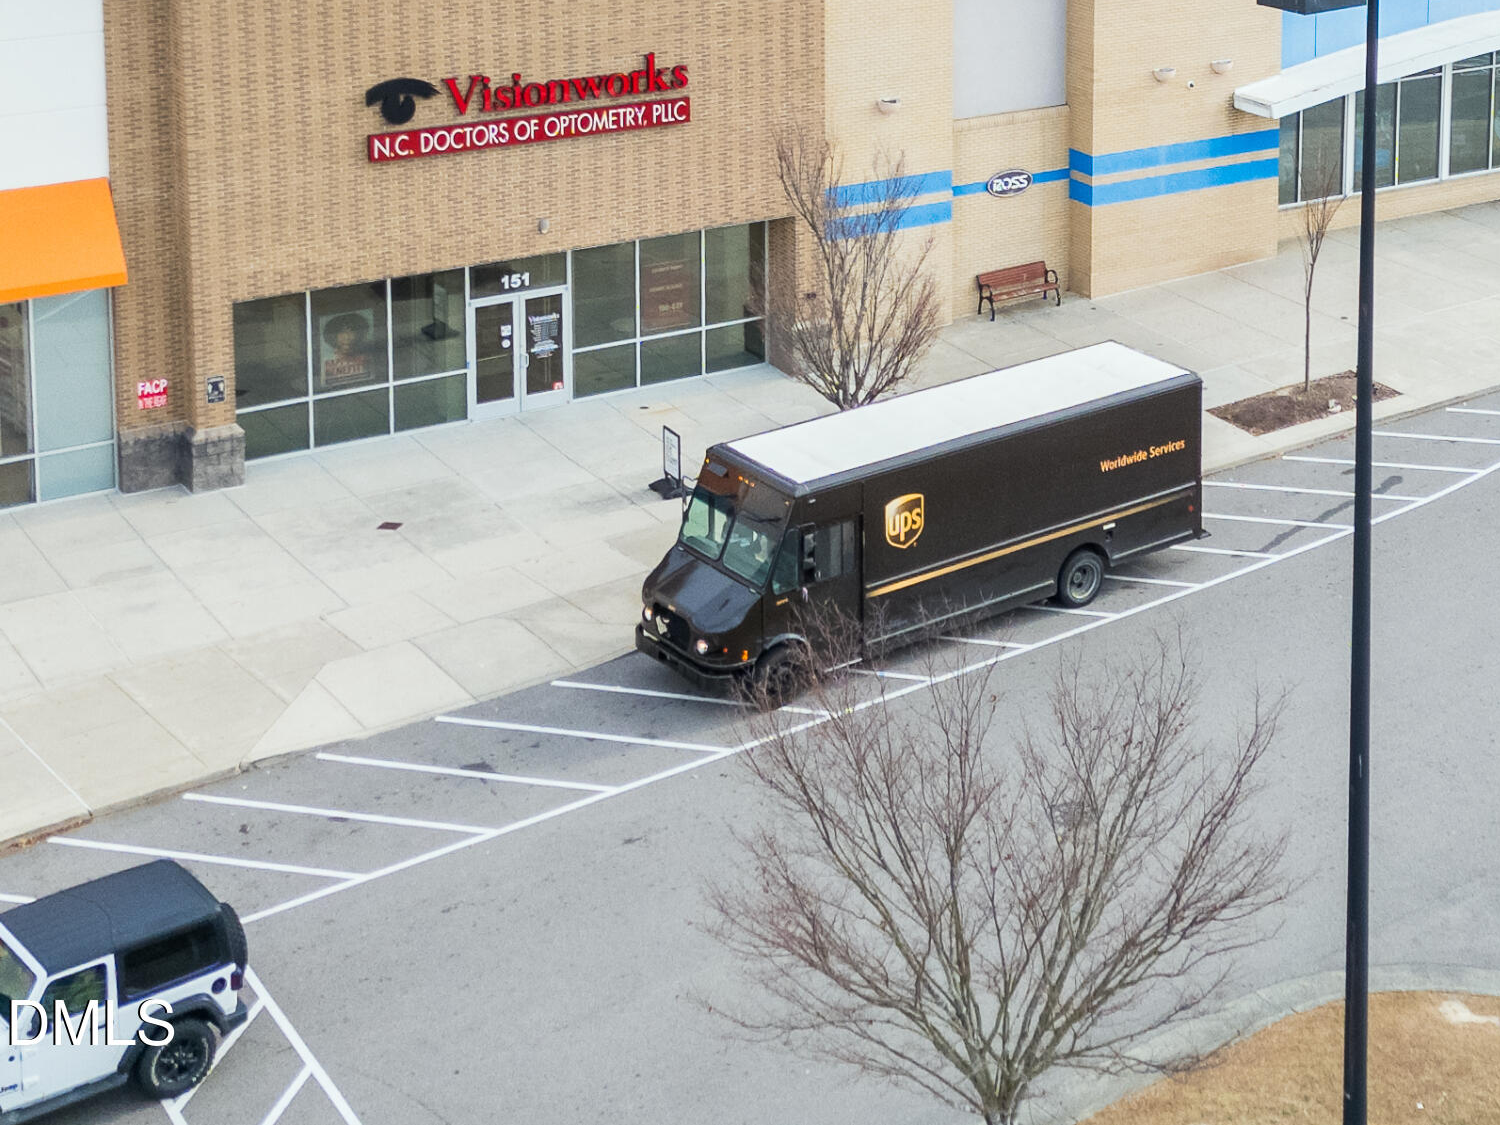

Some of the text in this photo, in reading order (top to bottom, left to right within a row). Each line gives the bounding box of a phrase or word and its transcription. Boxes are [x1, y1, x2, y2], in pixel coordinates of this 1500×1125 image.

[444, 52, 689, 115] Visionworks
[373, 101, 687, 160] N.C. DOCTORS OF OPTOMETRY, PLLC
[992, 174, 1029, 193] ROSS
[501, 272, 531, 290] 151
[137, 379, 168, 396] FACP
[1100, 439, 1186, 473] Worldwide Services
